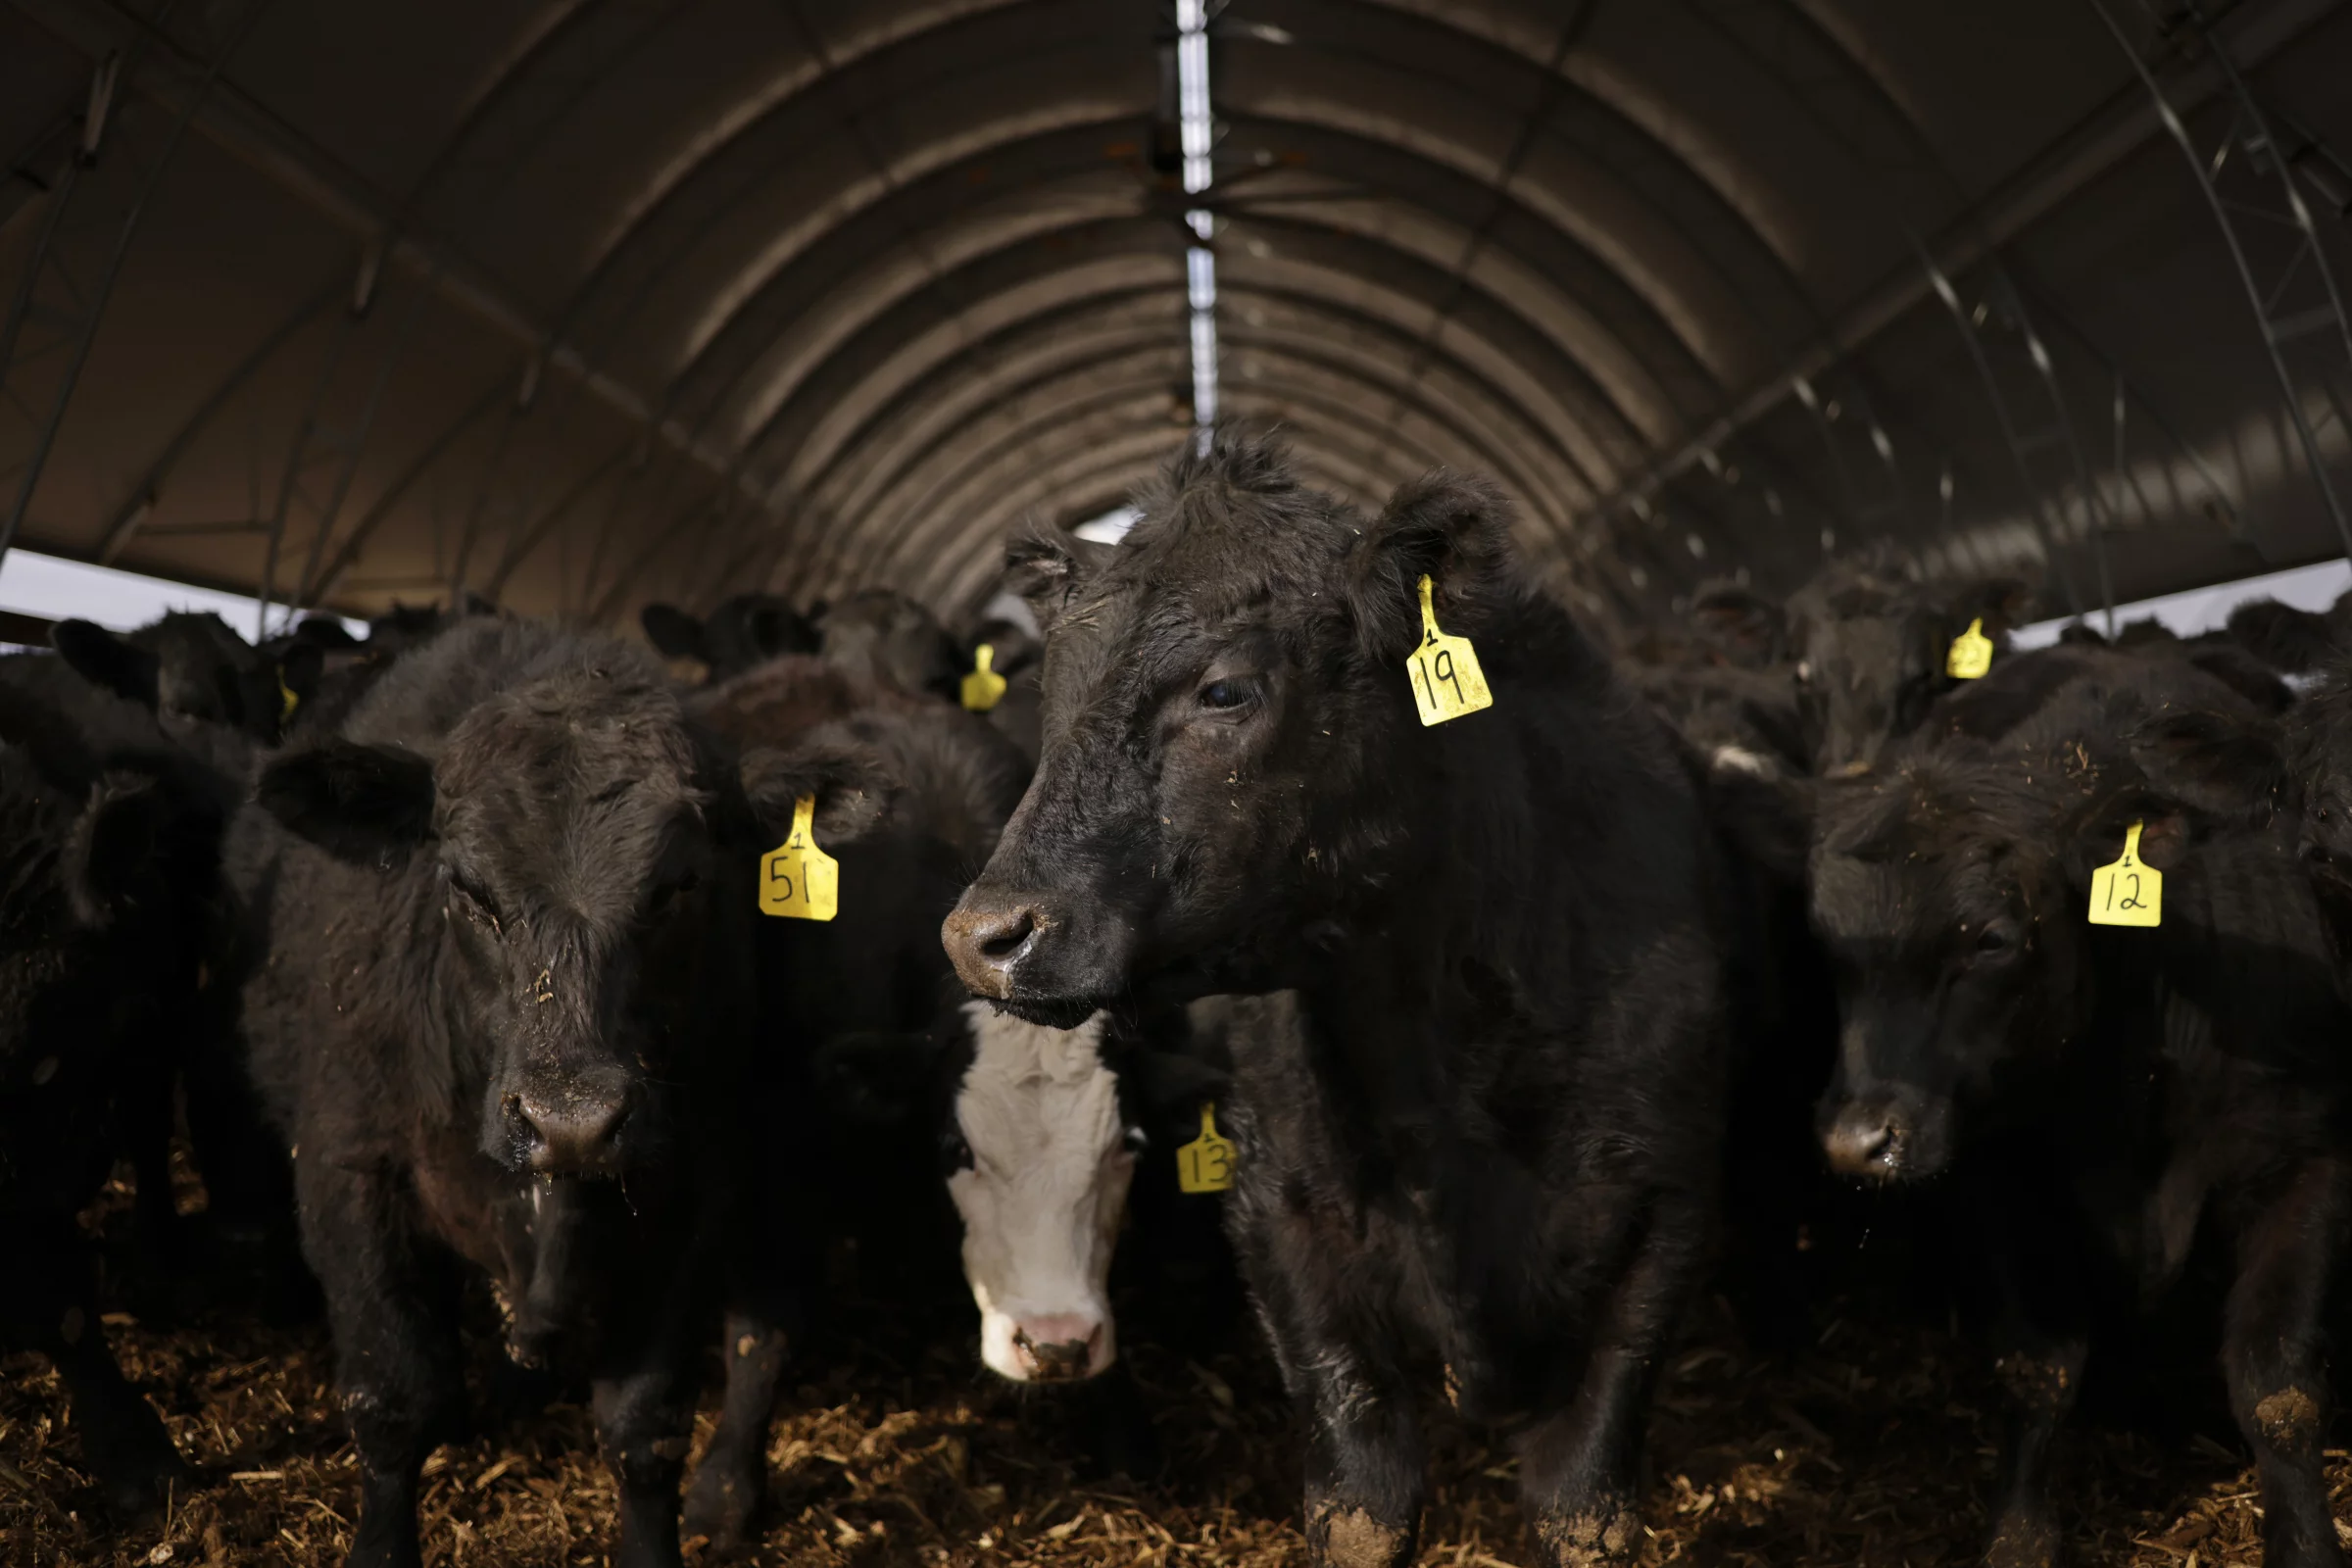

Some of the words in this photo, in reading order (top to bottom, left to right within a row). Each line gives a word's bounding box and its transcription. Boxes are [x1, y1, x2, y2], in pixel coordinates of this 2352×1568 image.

[1426, 628, 1439, 648] 1
[1419, 650, 1465, 710] 19
[791, 832, 806, 850] 1
[770, 856, 809, 904] 51
[2122, 855, 2132, 867] 1
[2106, 873, 2147, 911] 12
[1192, 1144, 1231, 1184] 13
